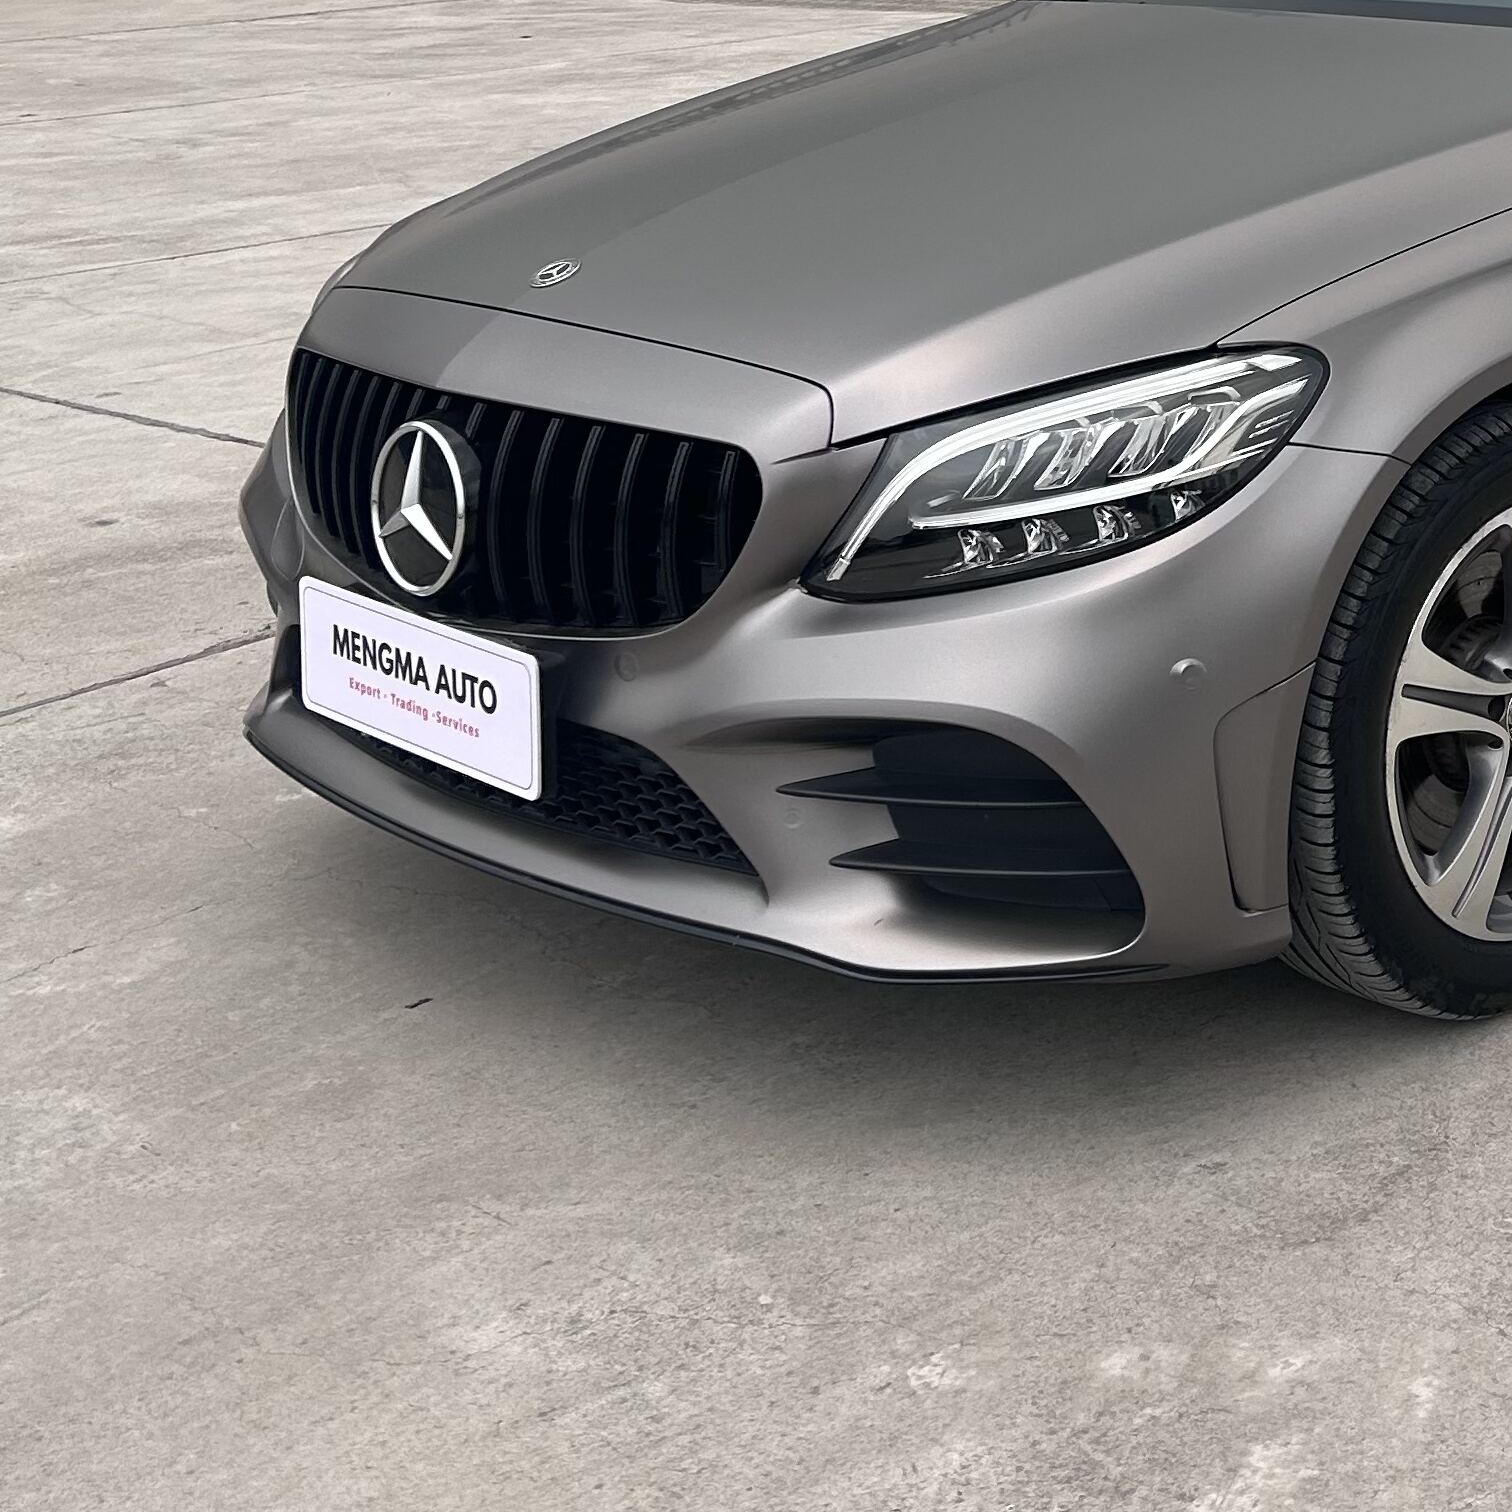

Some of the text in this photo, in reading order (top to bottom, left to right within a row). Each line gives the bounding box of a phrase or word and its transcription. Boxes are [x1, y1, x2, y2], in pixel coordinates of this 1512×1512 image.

[333, 624, 497, 715] MENGMA AUTO
[349, 677, 381, 700] Export
[391, 693, 429, 721] Trading
